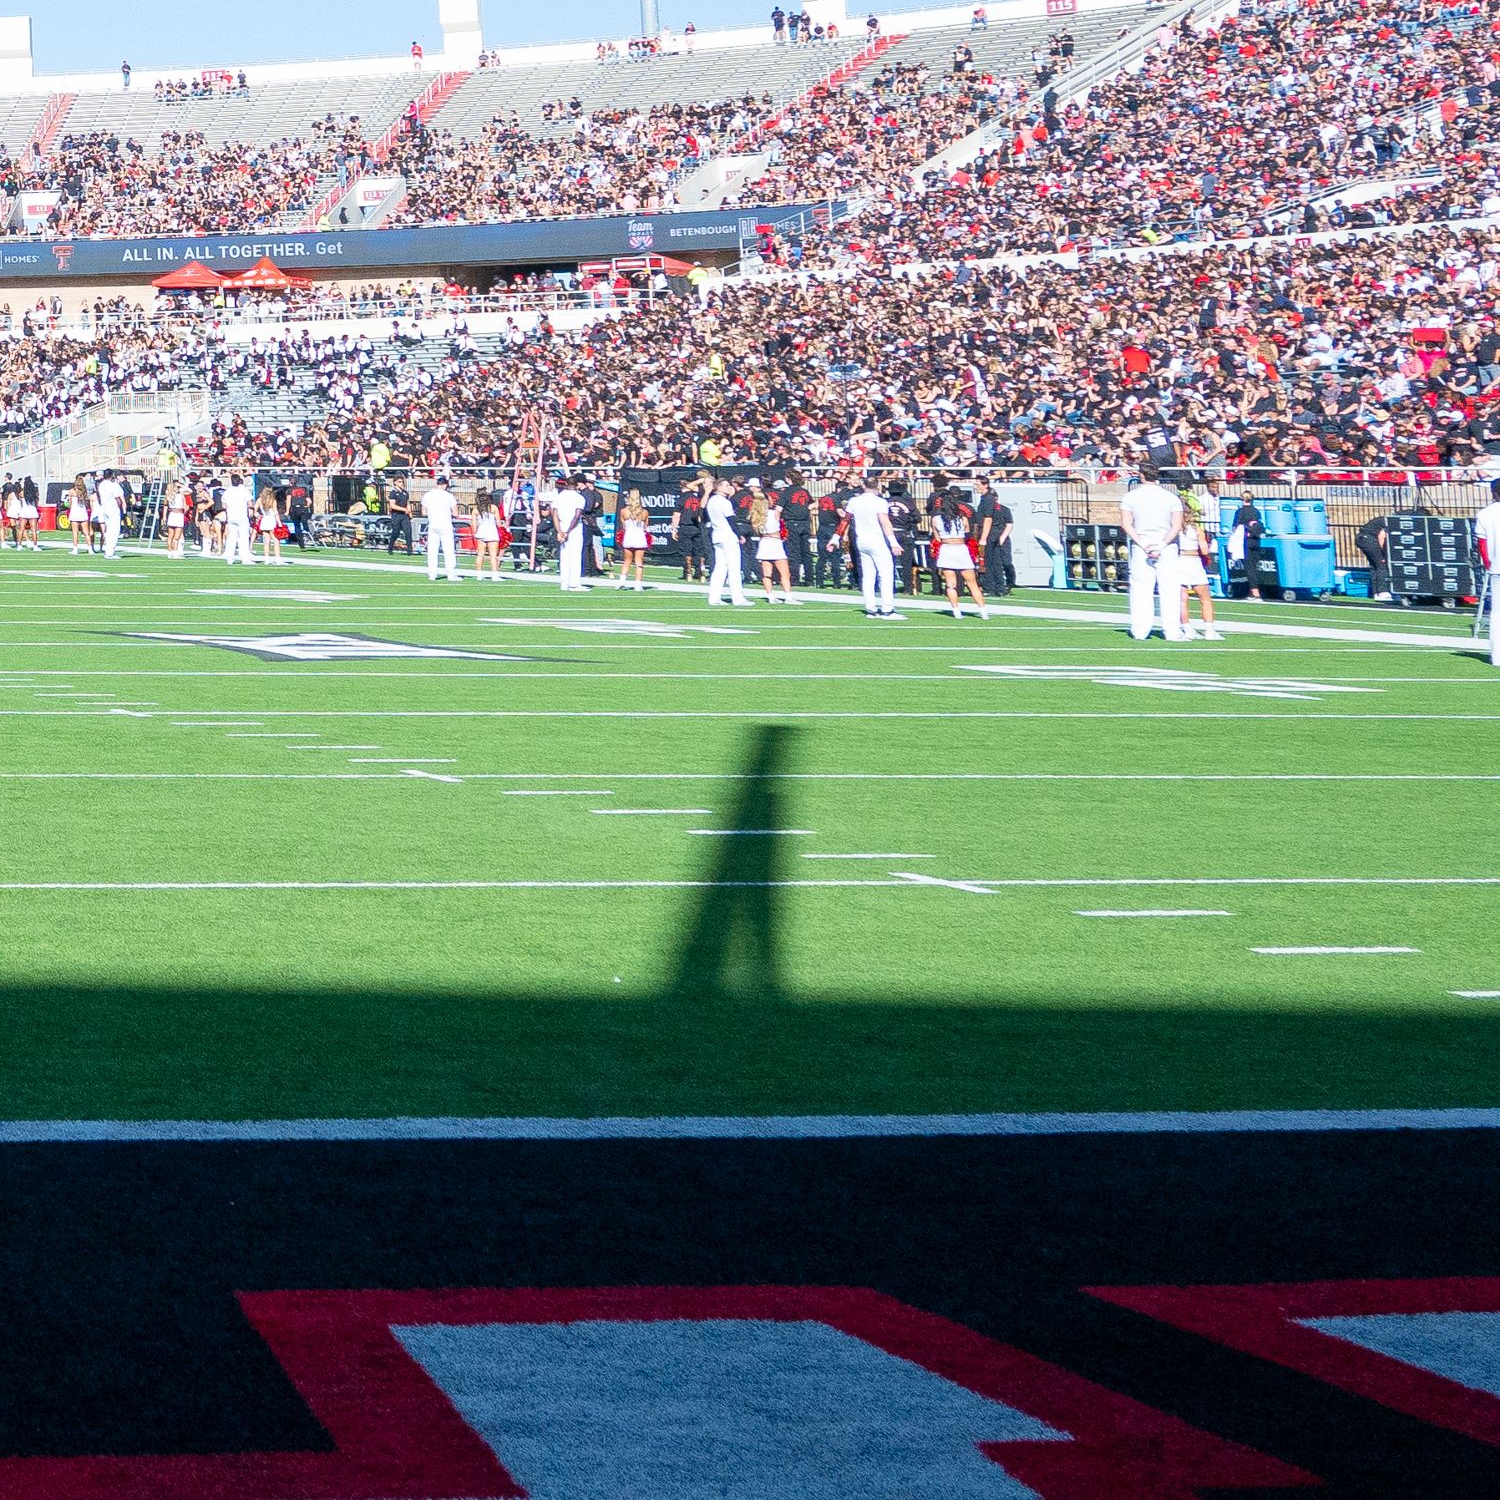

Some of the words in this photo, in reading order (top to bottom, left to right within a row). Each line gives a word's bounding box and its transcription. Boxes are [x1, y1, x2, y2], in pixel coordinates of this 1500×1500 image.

[670, 225, 737, 237] BETENBOUGH
[122, 249, 152, 262] ALL
[157, 248, 179, 261] IN.
[184, 247, 214, 260] ALL
[219, 242, 310, 258] TOGETHER.
[315, 241, 343, 255] Get
